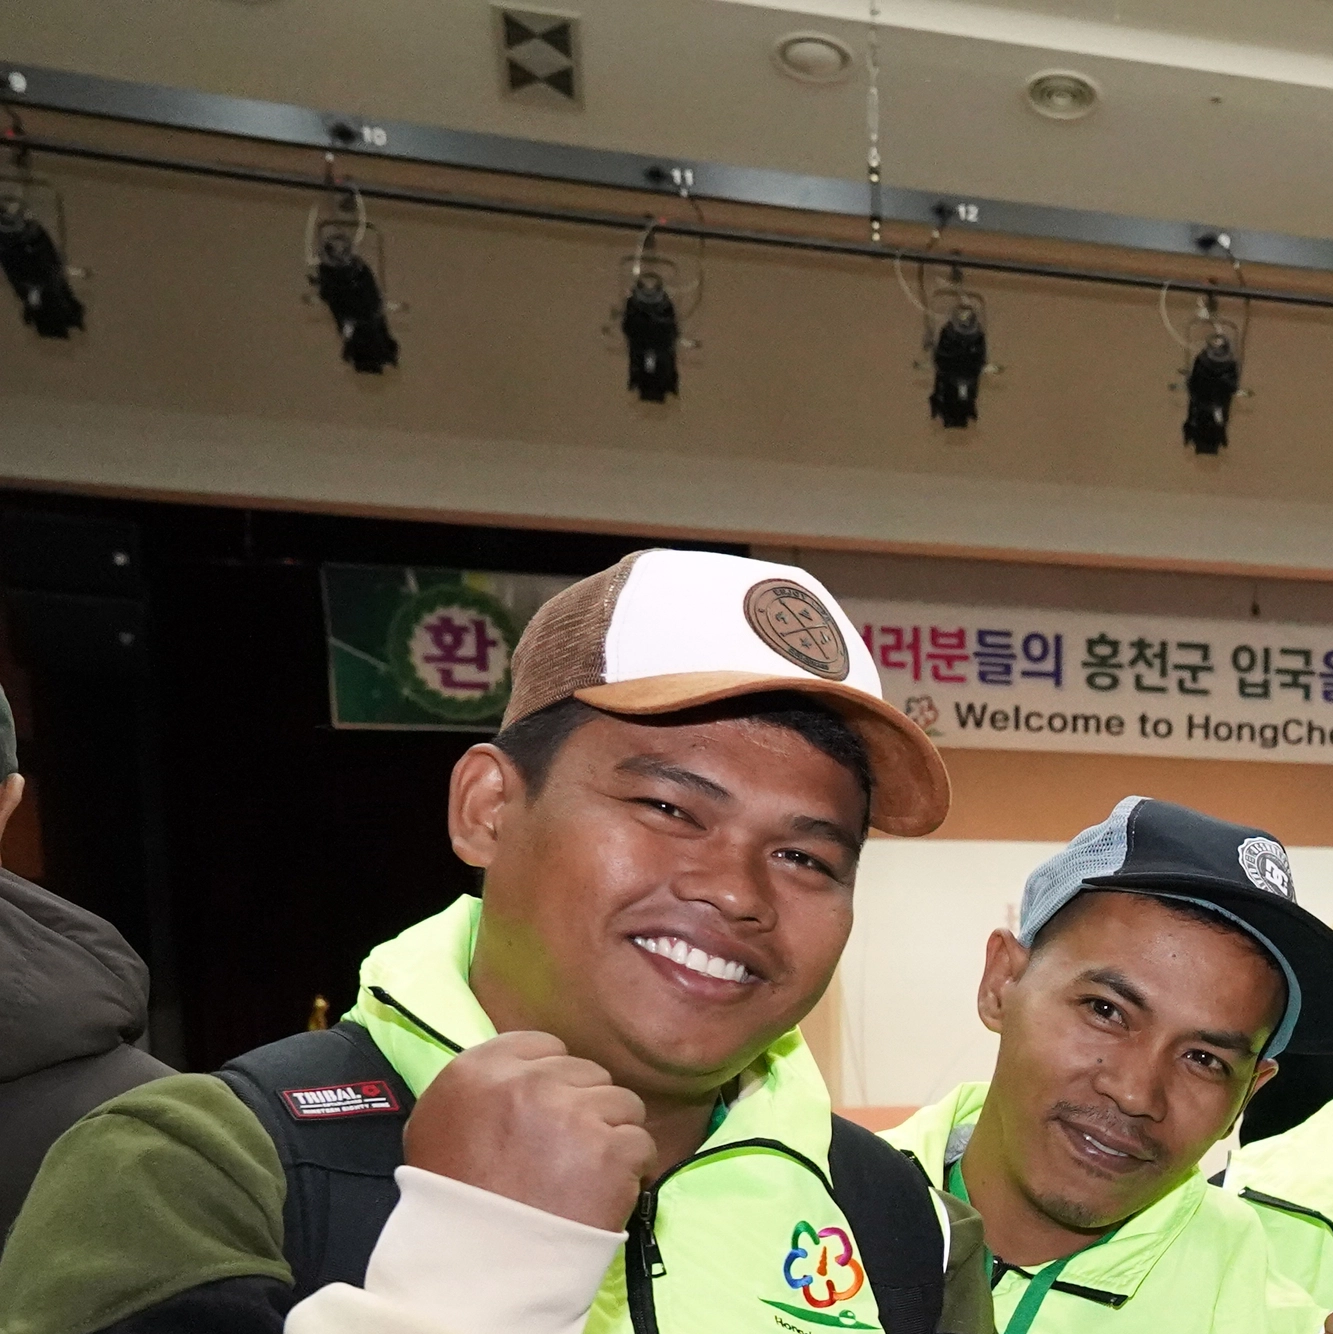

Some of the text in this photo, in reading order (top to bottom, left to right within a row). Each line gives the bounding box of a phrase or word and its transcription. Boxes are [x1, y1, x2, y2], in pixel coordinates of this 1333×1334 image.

[362, 125, 387, 146] 10
[671, 167, 694, 186] 11
[423, 616, 498, 690] 환
[862, 623, 1063, 688] 러분들의
[1081, 632, 1214, 696] 홍천군
[955, 701, 1125, 737] Welcome
[1140, 711, 1173, 738] to
[292, 1087, 362, 1104] TRIBAL
